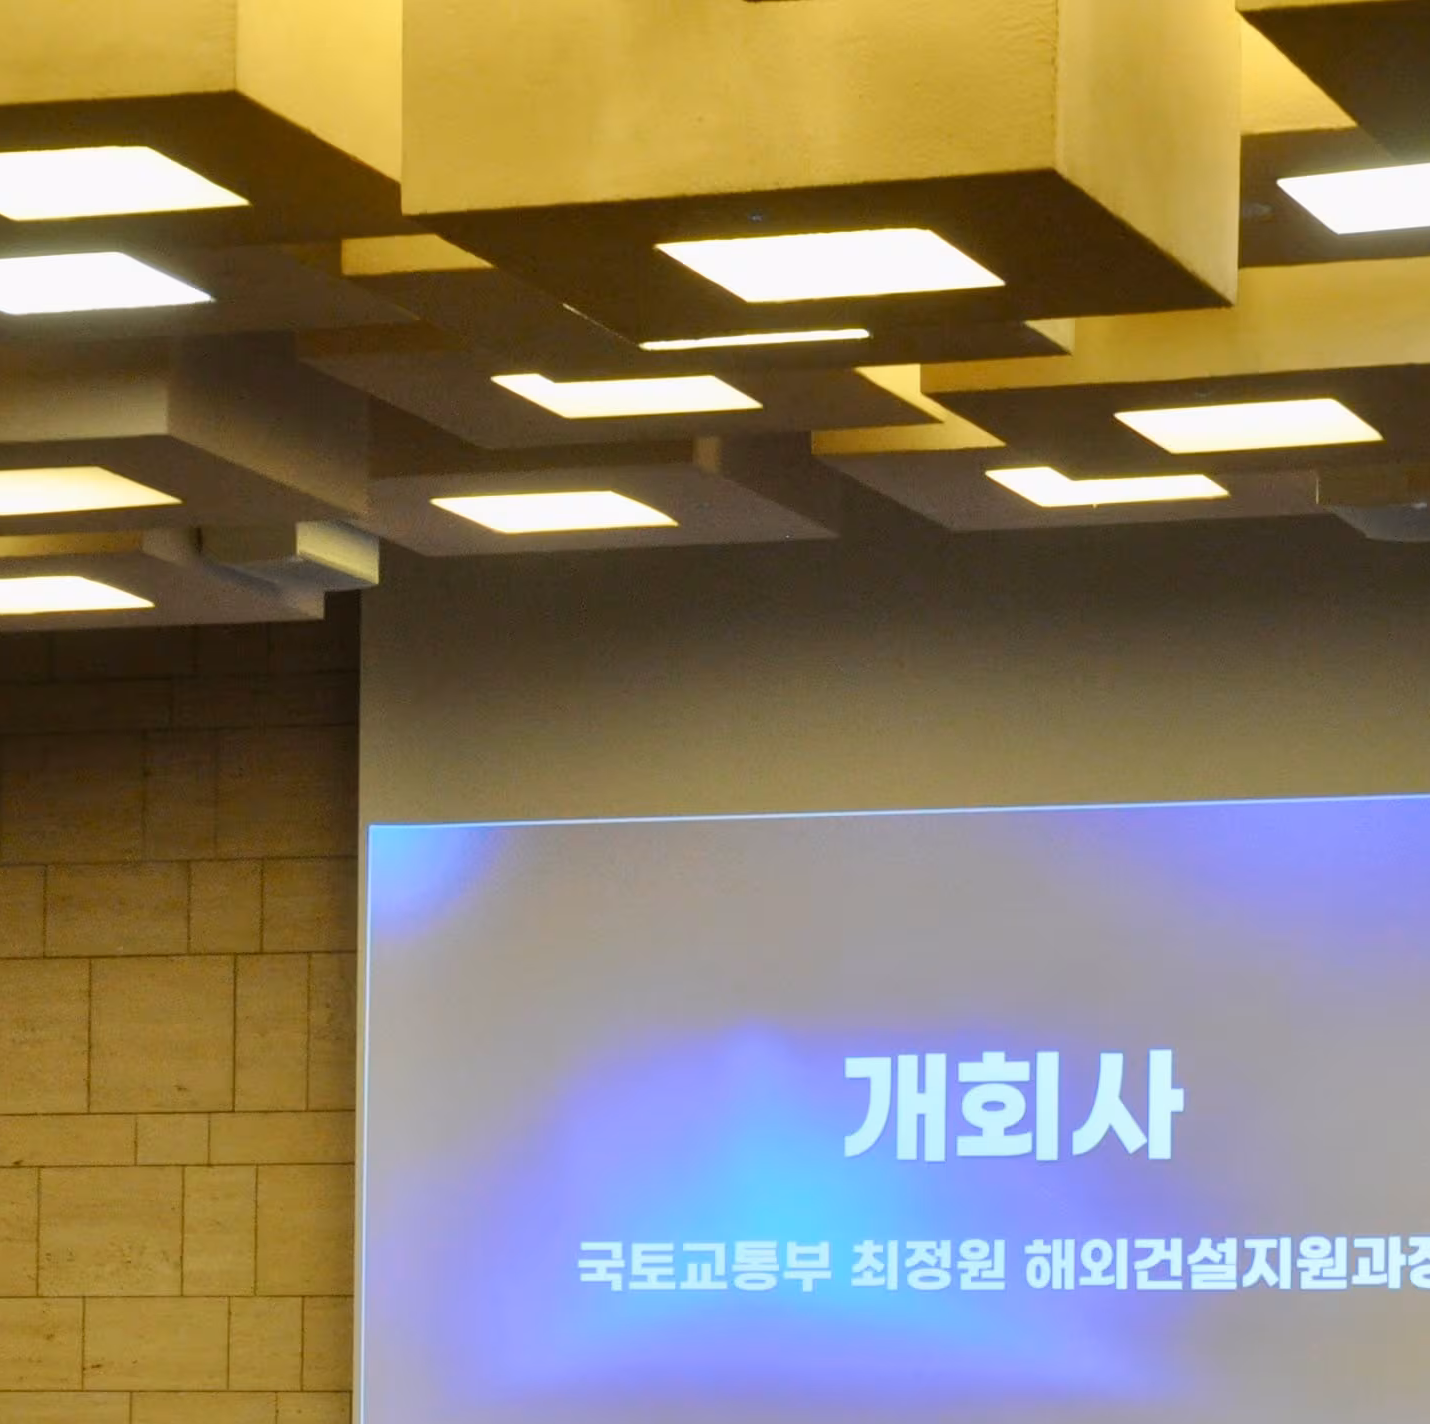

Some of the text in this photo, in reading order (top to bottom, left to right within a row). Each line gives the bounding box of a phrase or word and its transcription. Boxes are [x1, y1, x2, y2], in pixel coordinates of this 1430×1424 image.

[843, 1047, 1184, 1162] 개회사
[577, 1240, 832, 1293] 국토교통부
[851, 1238, 1006, 1292] 최정원
